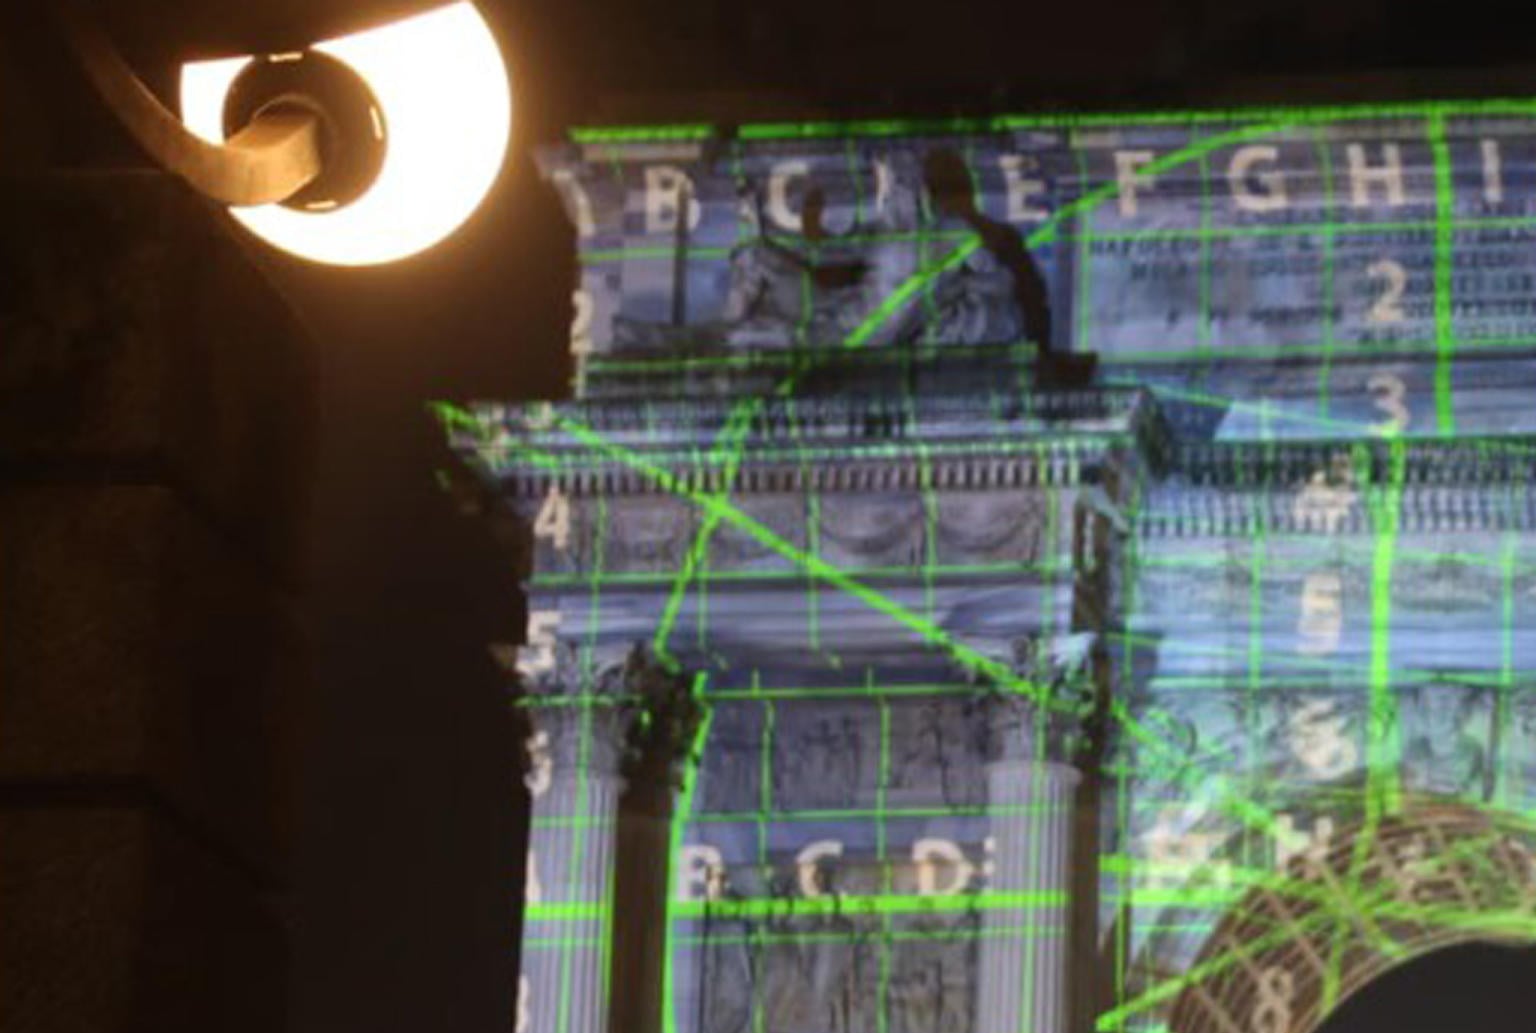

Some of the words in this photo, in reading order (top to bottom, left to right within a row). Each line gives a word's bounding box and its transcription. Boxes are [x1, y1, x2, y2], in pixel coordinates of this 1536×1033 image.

[1000, 153, 1050, 222] E
[1113, 149, 1156, 218] F
[1227, 145, 1288, 213] G
[1346, 142, 1405, 210] H
[1480, 138, 1504, 204] I
[1366, 263, 1408, 324] 2
[1366, 373, 1411, 438] 3
[533, 484, 571, 549] 4
